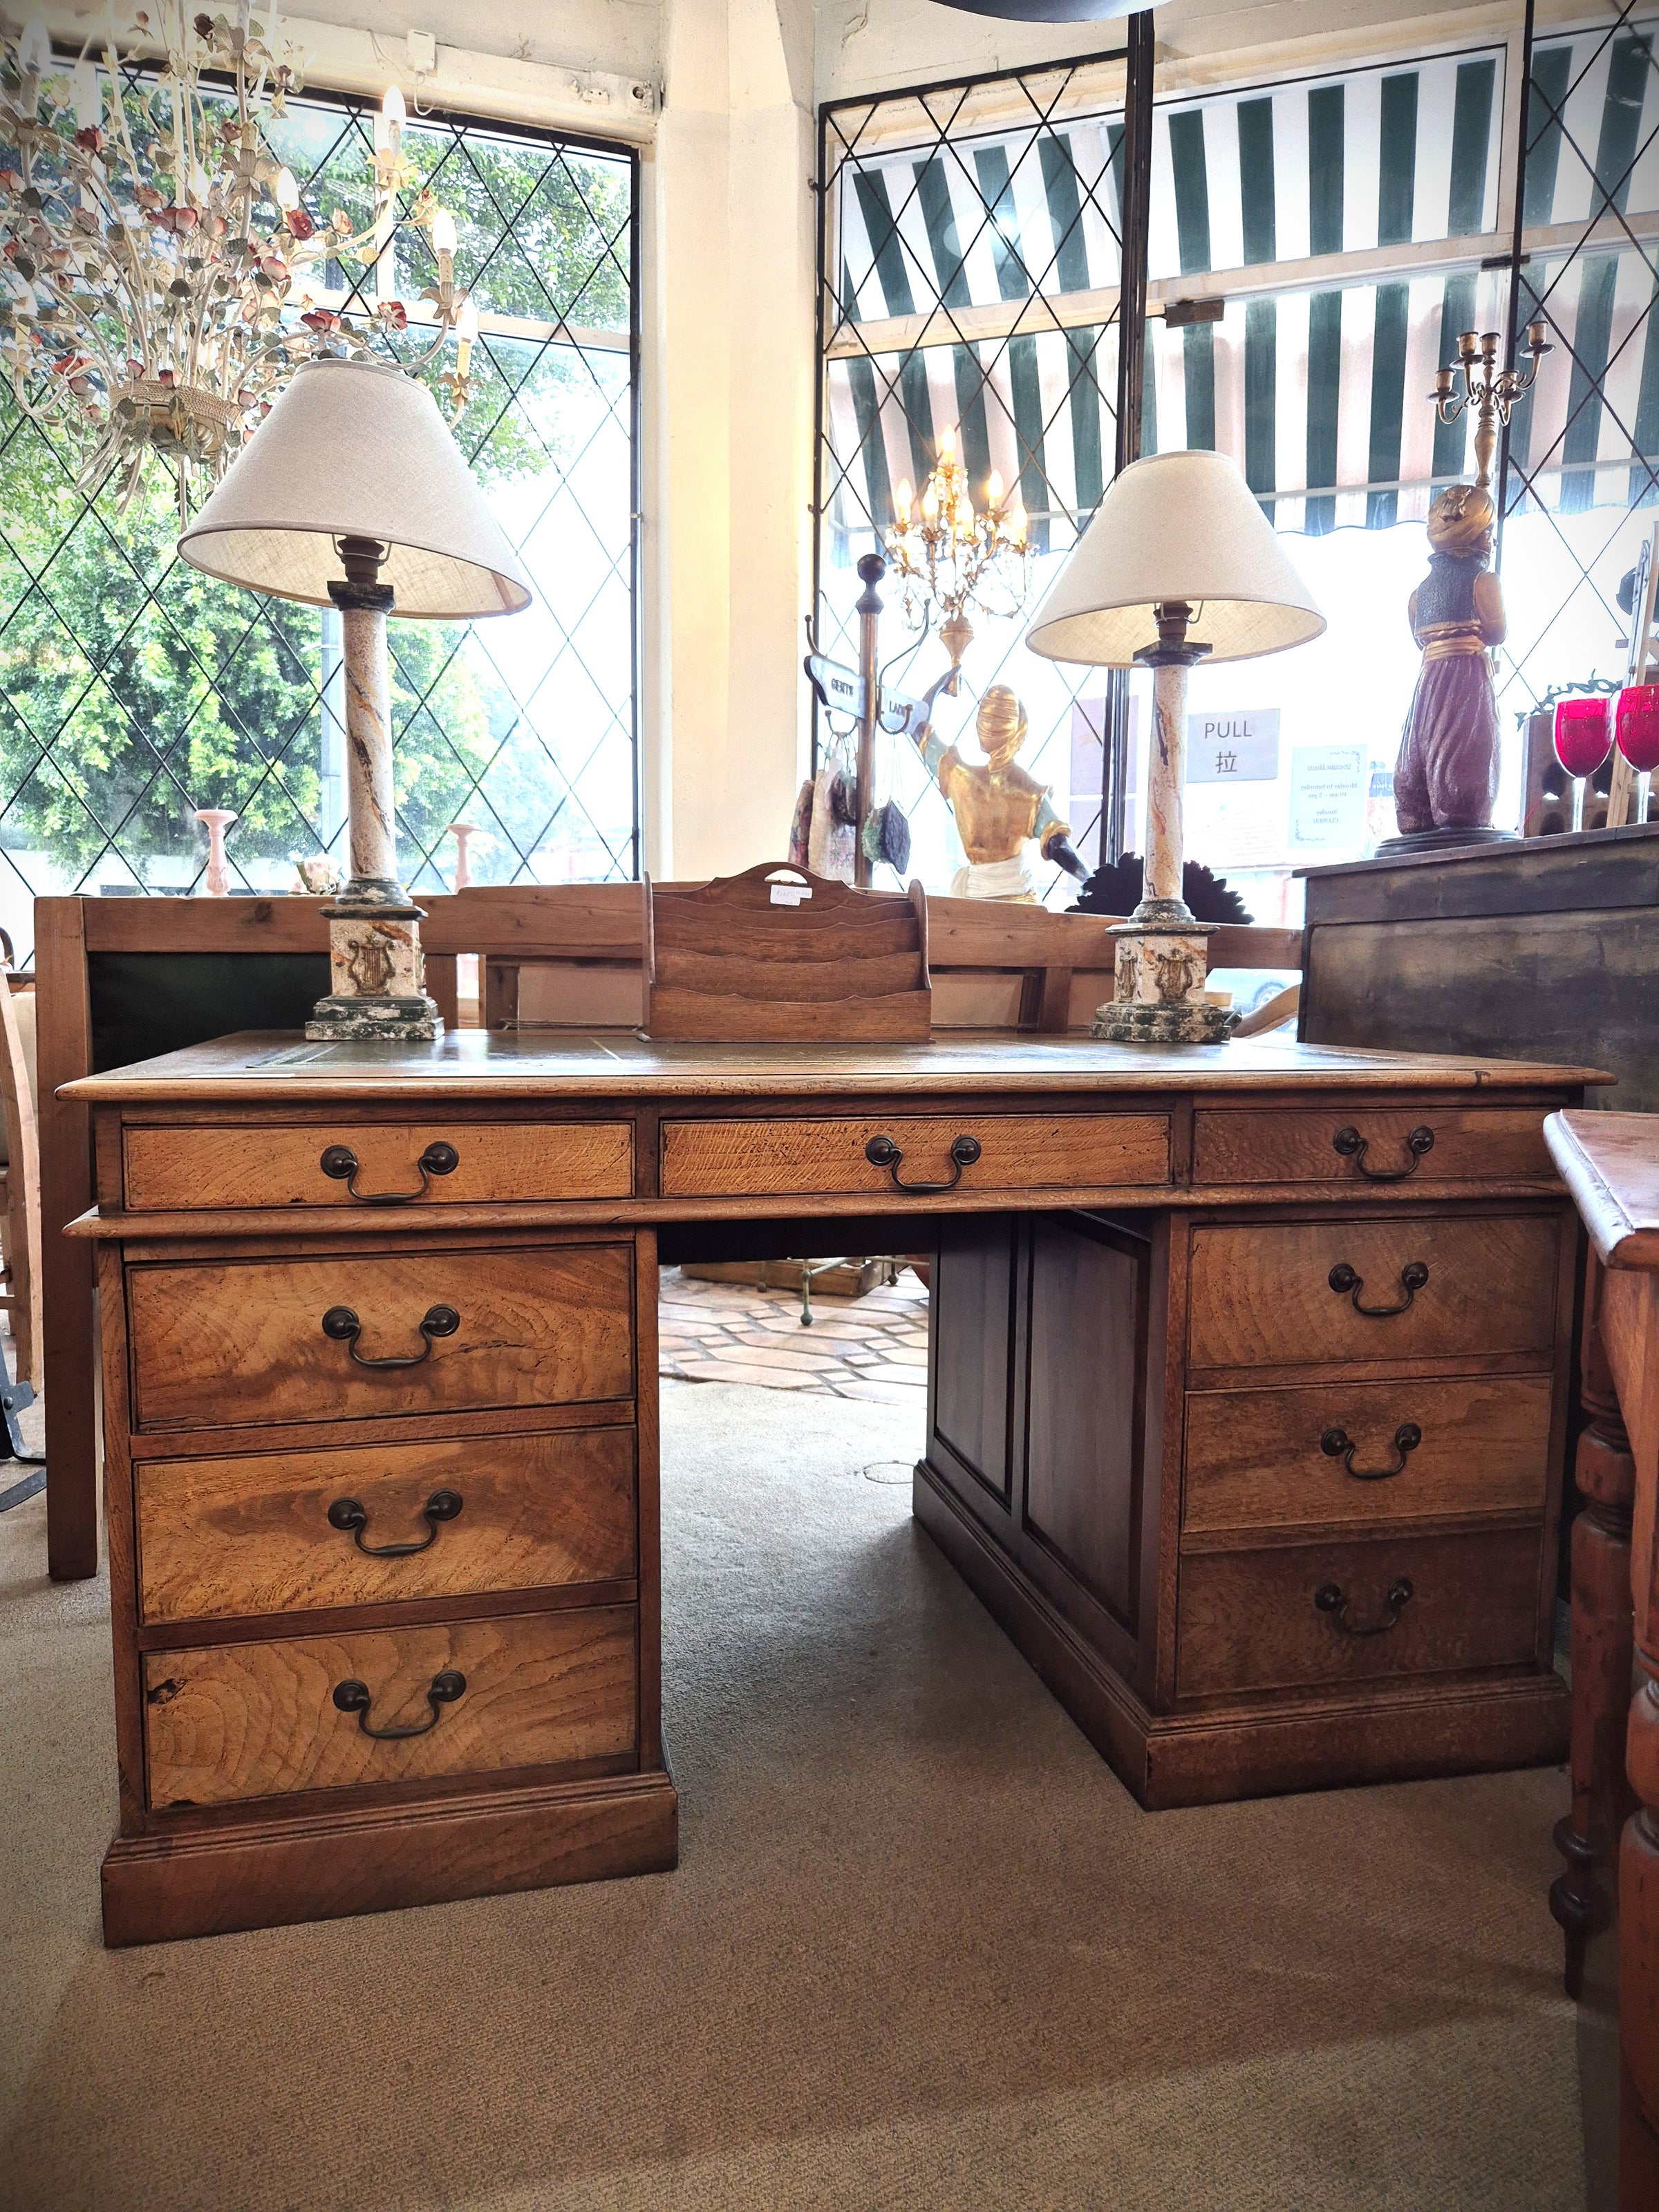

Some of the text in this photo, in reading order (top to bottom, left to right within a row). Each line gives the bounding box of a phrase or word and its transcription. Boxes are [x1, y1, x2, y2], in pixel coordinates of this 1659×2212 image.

[831, 678, 854, 697] GENTS
[1204, 720, 1252, 739] PULL
[1215, 751, 1237, 774] 拉
